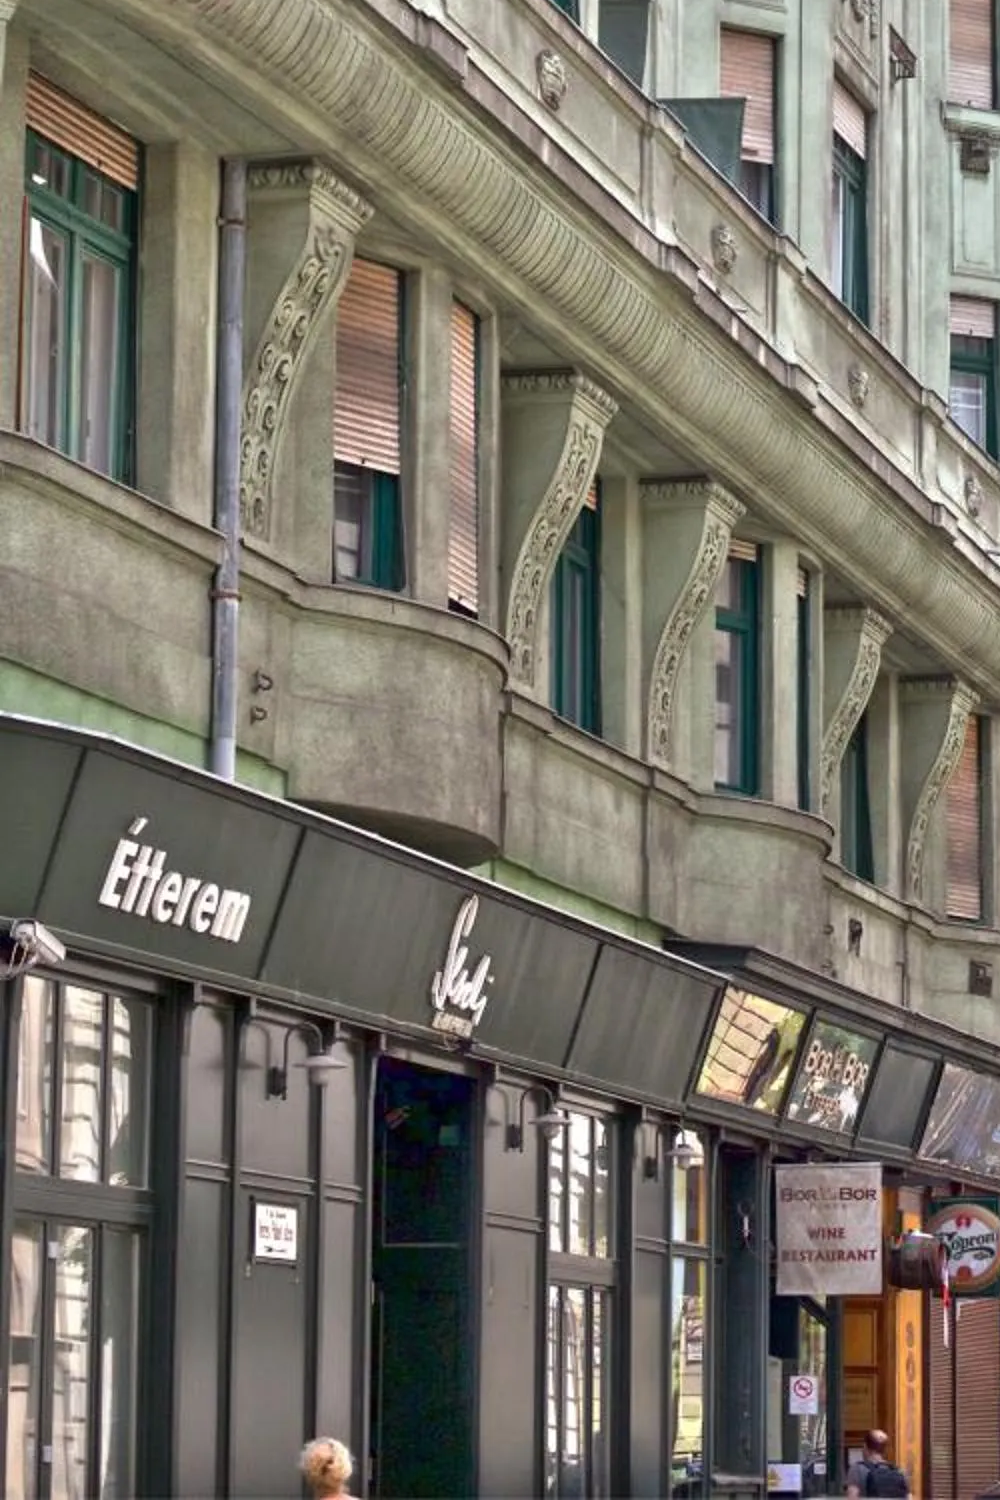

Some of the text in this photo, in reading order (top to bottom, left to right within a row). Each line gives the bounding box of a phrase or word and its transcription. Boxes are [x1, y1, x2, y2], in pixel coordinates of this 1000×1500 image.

[98, 816, 251, 943] Étterem
[807, 1226, 846, 1240] WINE
[781, 1249, 877, 1262] RESTAURANT
